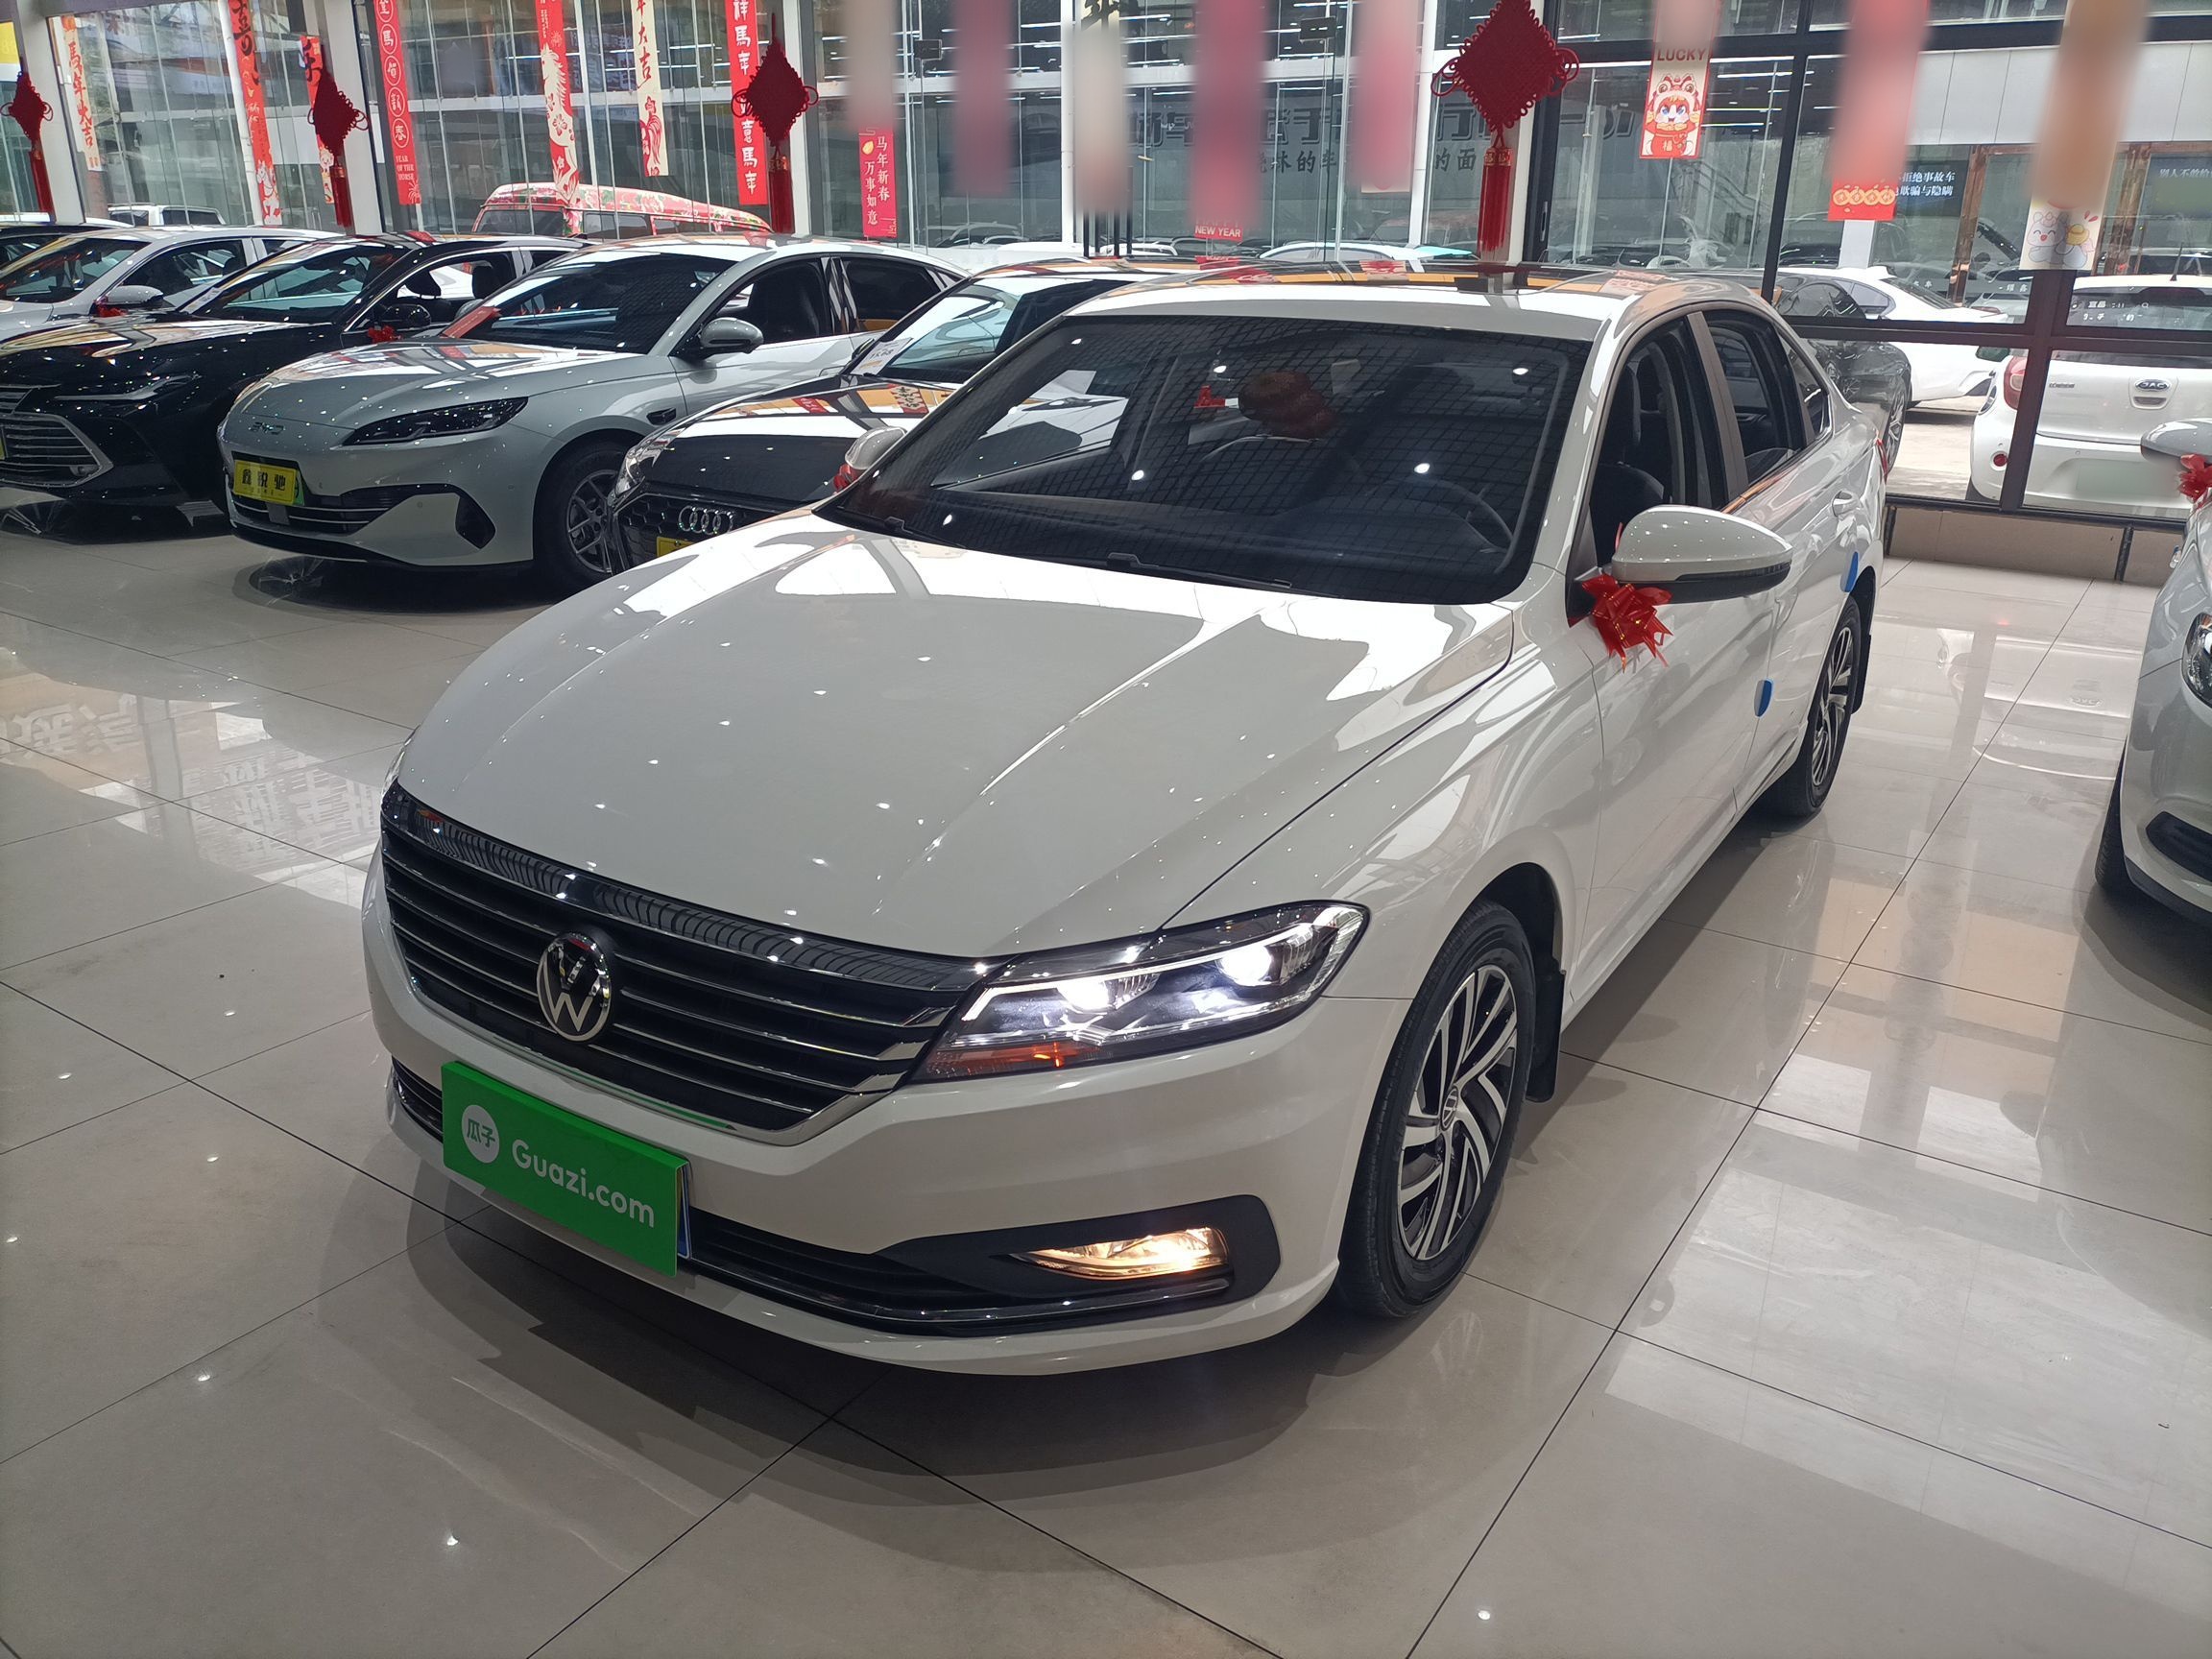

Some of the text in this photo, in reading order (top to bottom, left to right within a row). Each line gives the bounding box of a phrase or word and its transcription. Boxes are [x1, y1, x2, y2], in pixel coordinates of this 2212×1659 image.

[1657, 48, 1706, 61] LUCKY
[877, 135, 890, 202] 马年新春
[1900, 171, 1956, 182] 拒绝事故车
[865, 160, 878, 226] 万事如意
[1194, 225, 1241, 238] NEW YEAR
[467, 1118, 495, 1148] 瓜子
[512, 1139, 654, 1228] Guazi.com
